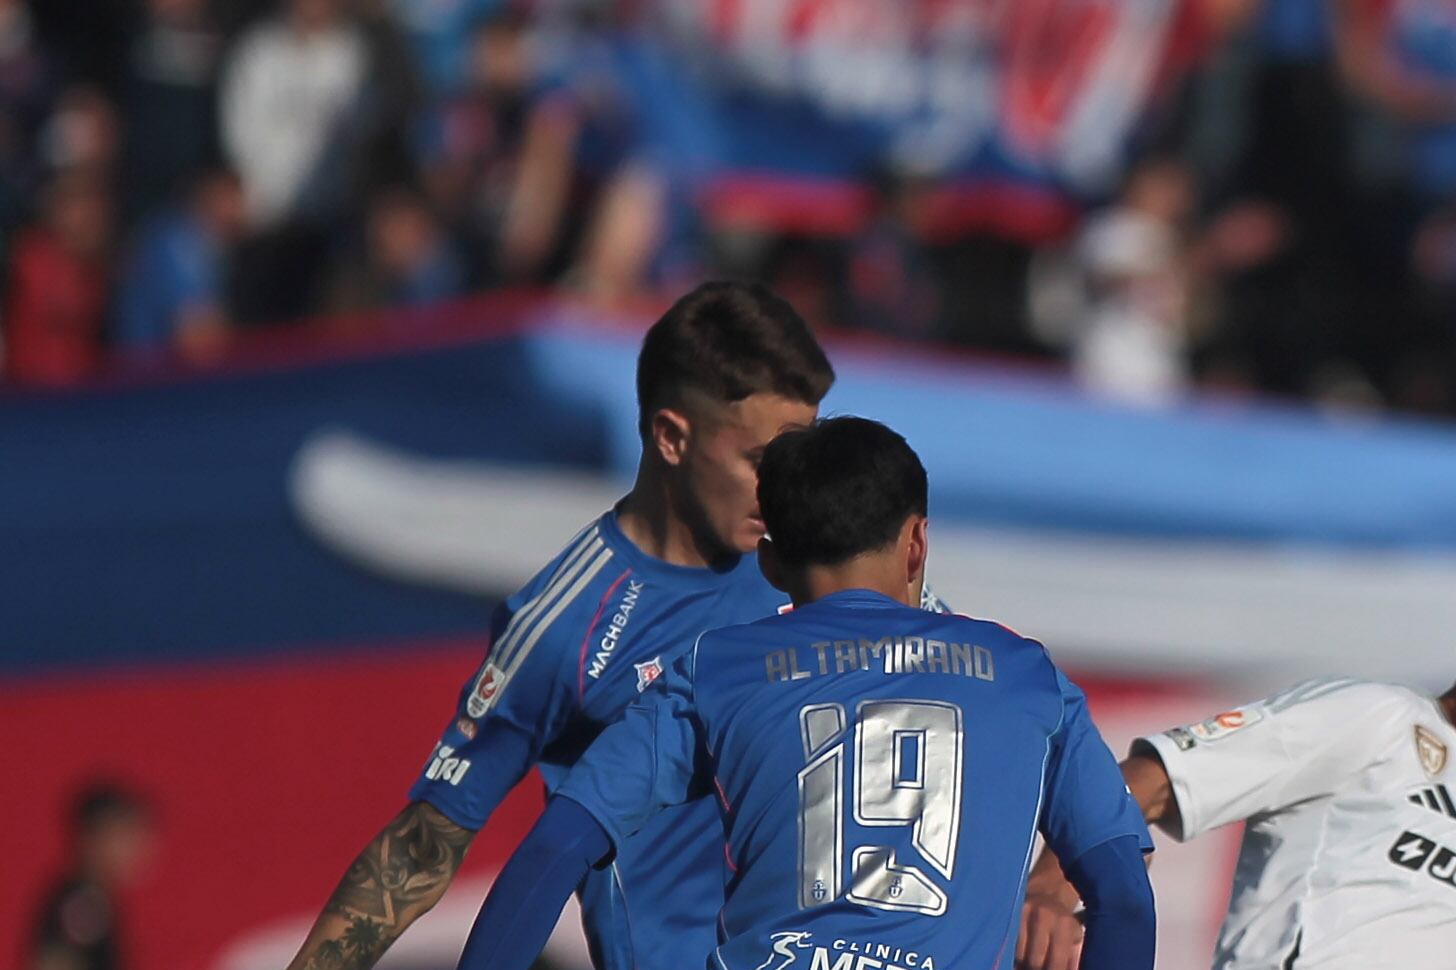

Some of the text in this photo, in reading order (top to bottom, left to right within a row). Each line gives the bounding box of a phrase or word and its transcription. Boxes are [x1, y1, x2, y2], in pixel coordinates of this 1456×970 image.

[588, 579, 644, 679] MACHBANK
[765, 636, 995, 682] ALTAMIRANO
[798, 699, 963, 916] 19
